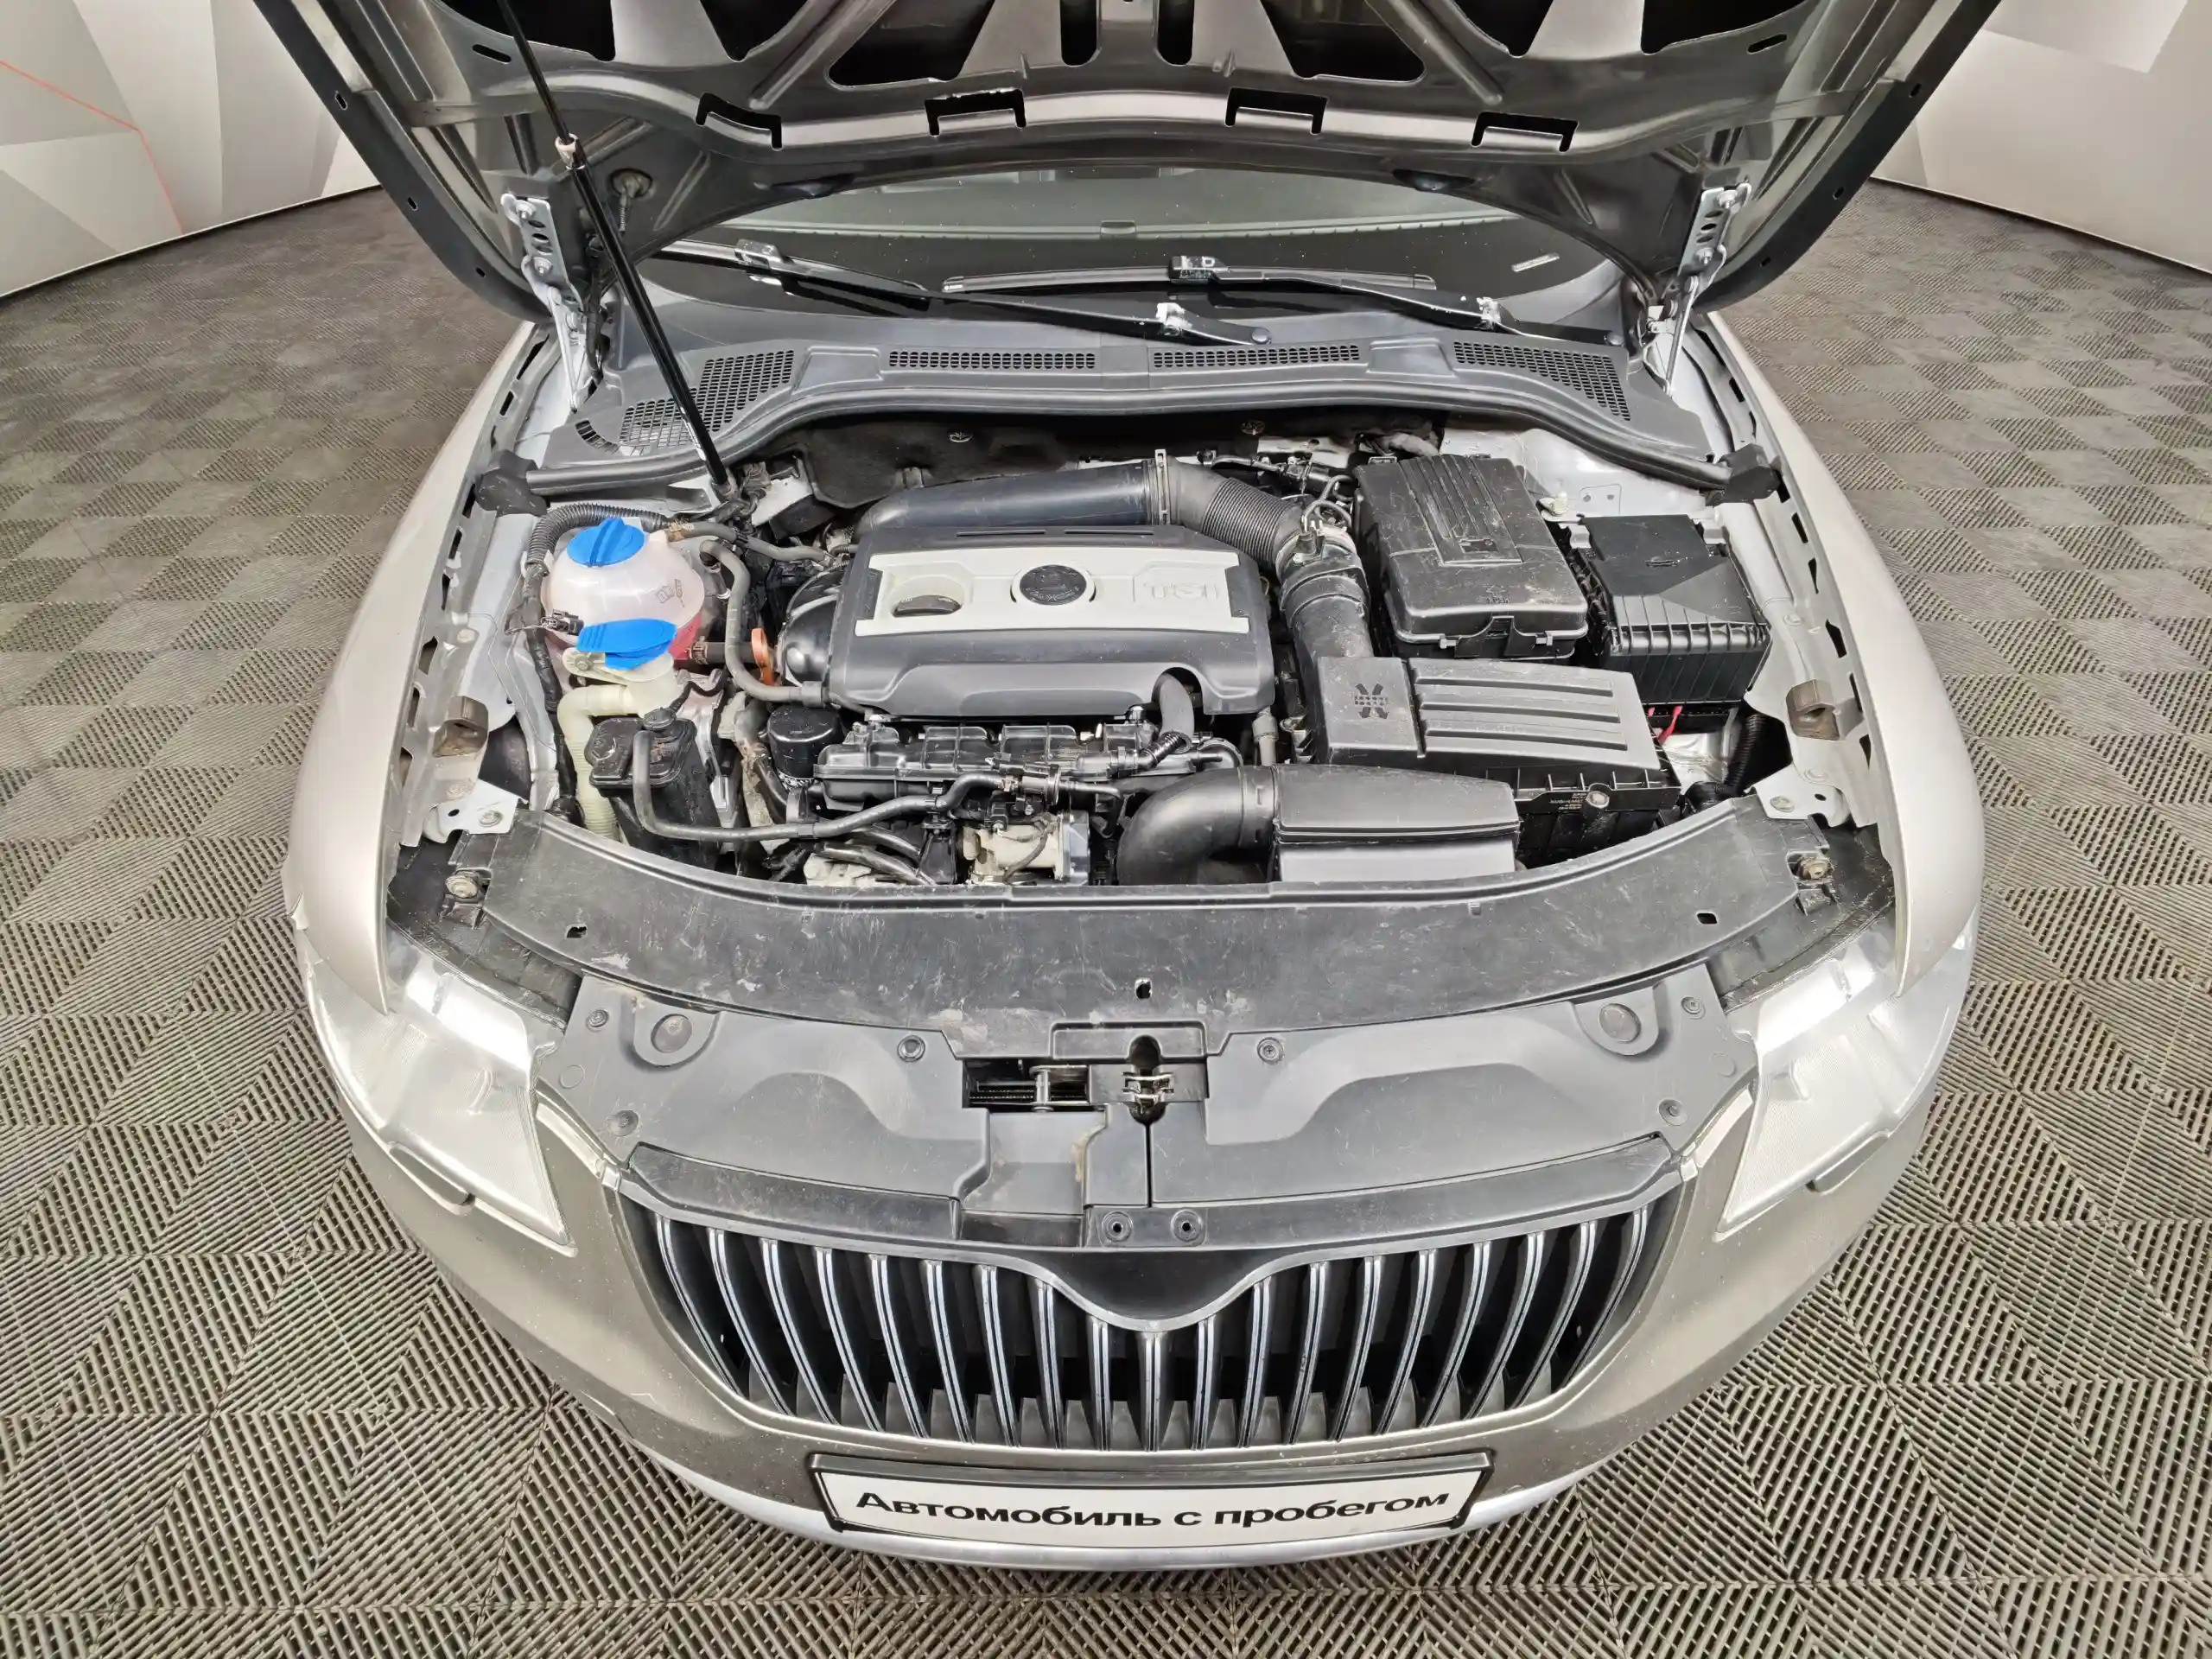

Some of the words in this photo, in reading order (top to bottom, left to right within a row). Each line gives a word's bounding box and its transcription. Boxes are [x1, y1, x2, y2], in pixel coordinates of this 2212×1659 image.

[856, 1492, 1161, 1528] Автомобиль
[1173, 1511, 1202, 1526] с
[1214, 1493, 1450, 1529] пробегом
